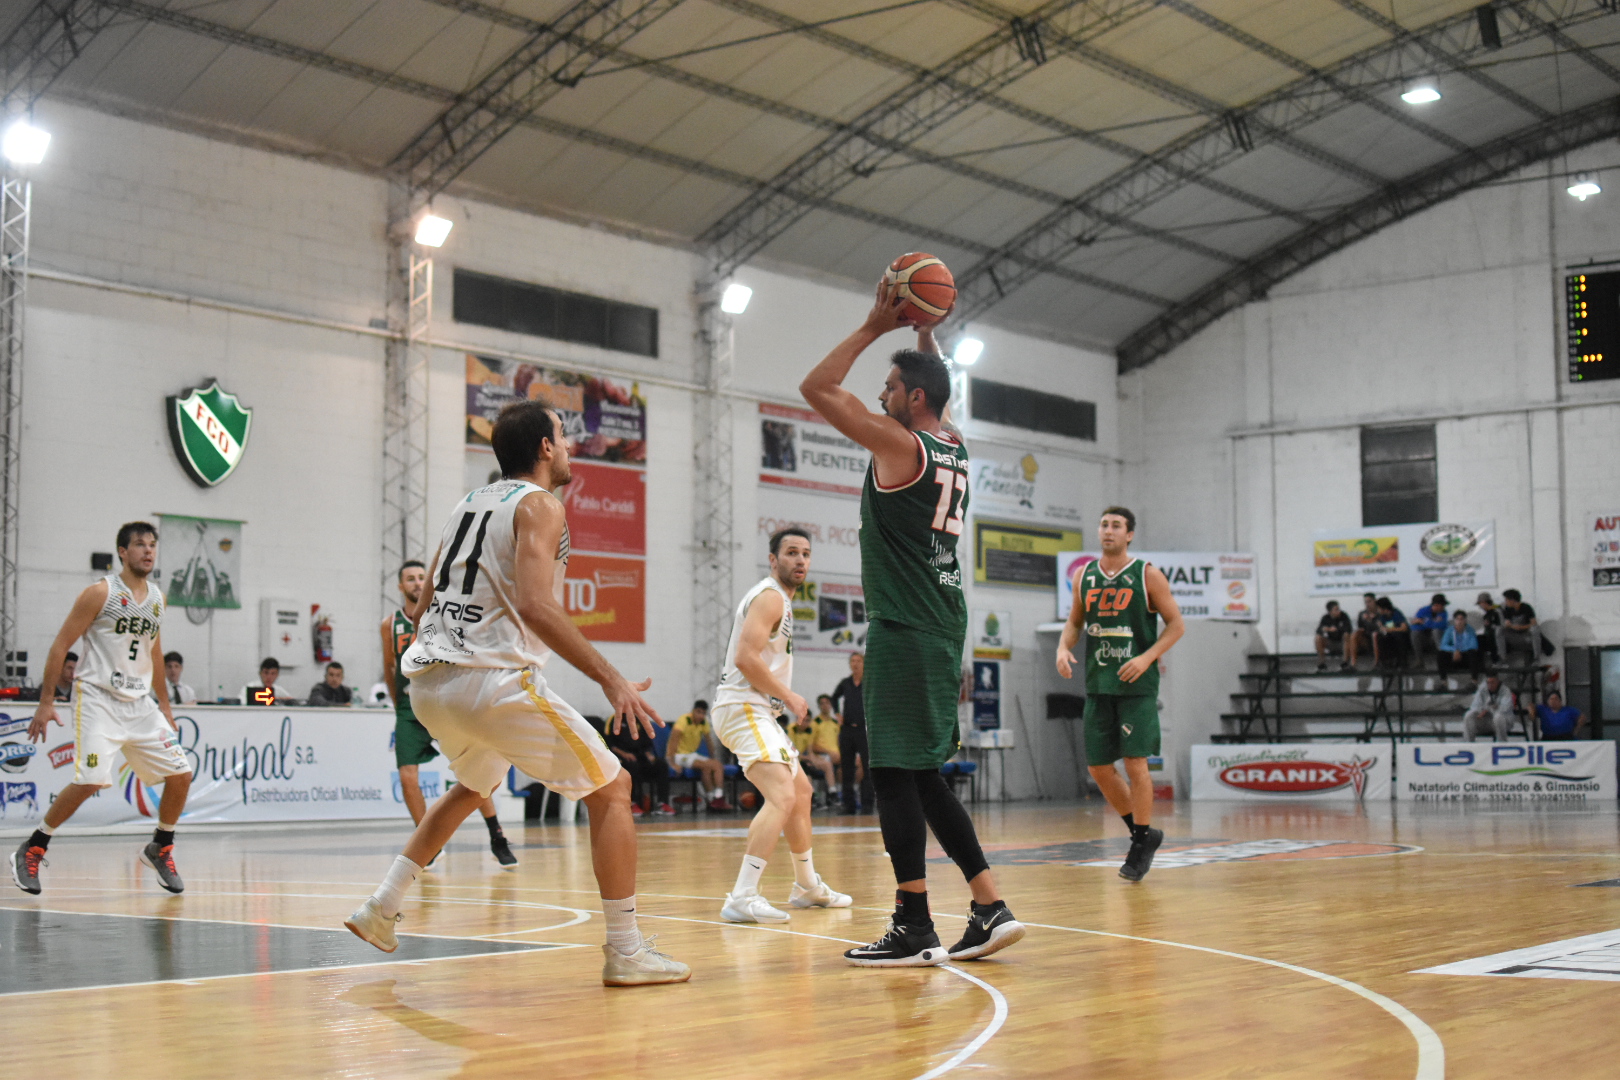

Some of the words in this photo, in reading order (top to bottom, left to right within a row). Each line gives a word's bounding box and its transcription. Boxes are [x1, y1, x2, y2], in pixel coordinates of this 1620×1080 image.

[196, 403, 229, 453] FCO
[802, 450, 866, 473] FUENTES
[434, 510, 494, 595] 11
[1086, 588, 1134, 612] FCO
[128, 640, 139, 661] 5
[0, 744, 36, 762] OREO
[174, 716, 294, 805] Brupal
[1414, 747, 1475, 766] La
[1491, 745, 1577, 765] Pile
[1225, 768, 1339, 783] GRANIX
[251, 787, 309, 803] Distribuidora
[311, 786, 338, 801] Oficial
[341, 786, 382, 801] Mondelez
[1409, 782, 1460, 793] Natatorio
[1463, 781, 1530, 793] Climatizado
[1533, 781, 1543, 792] &
[1546, 781, 1601, 792] Gimnasio
